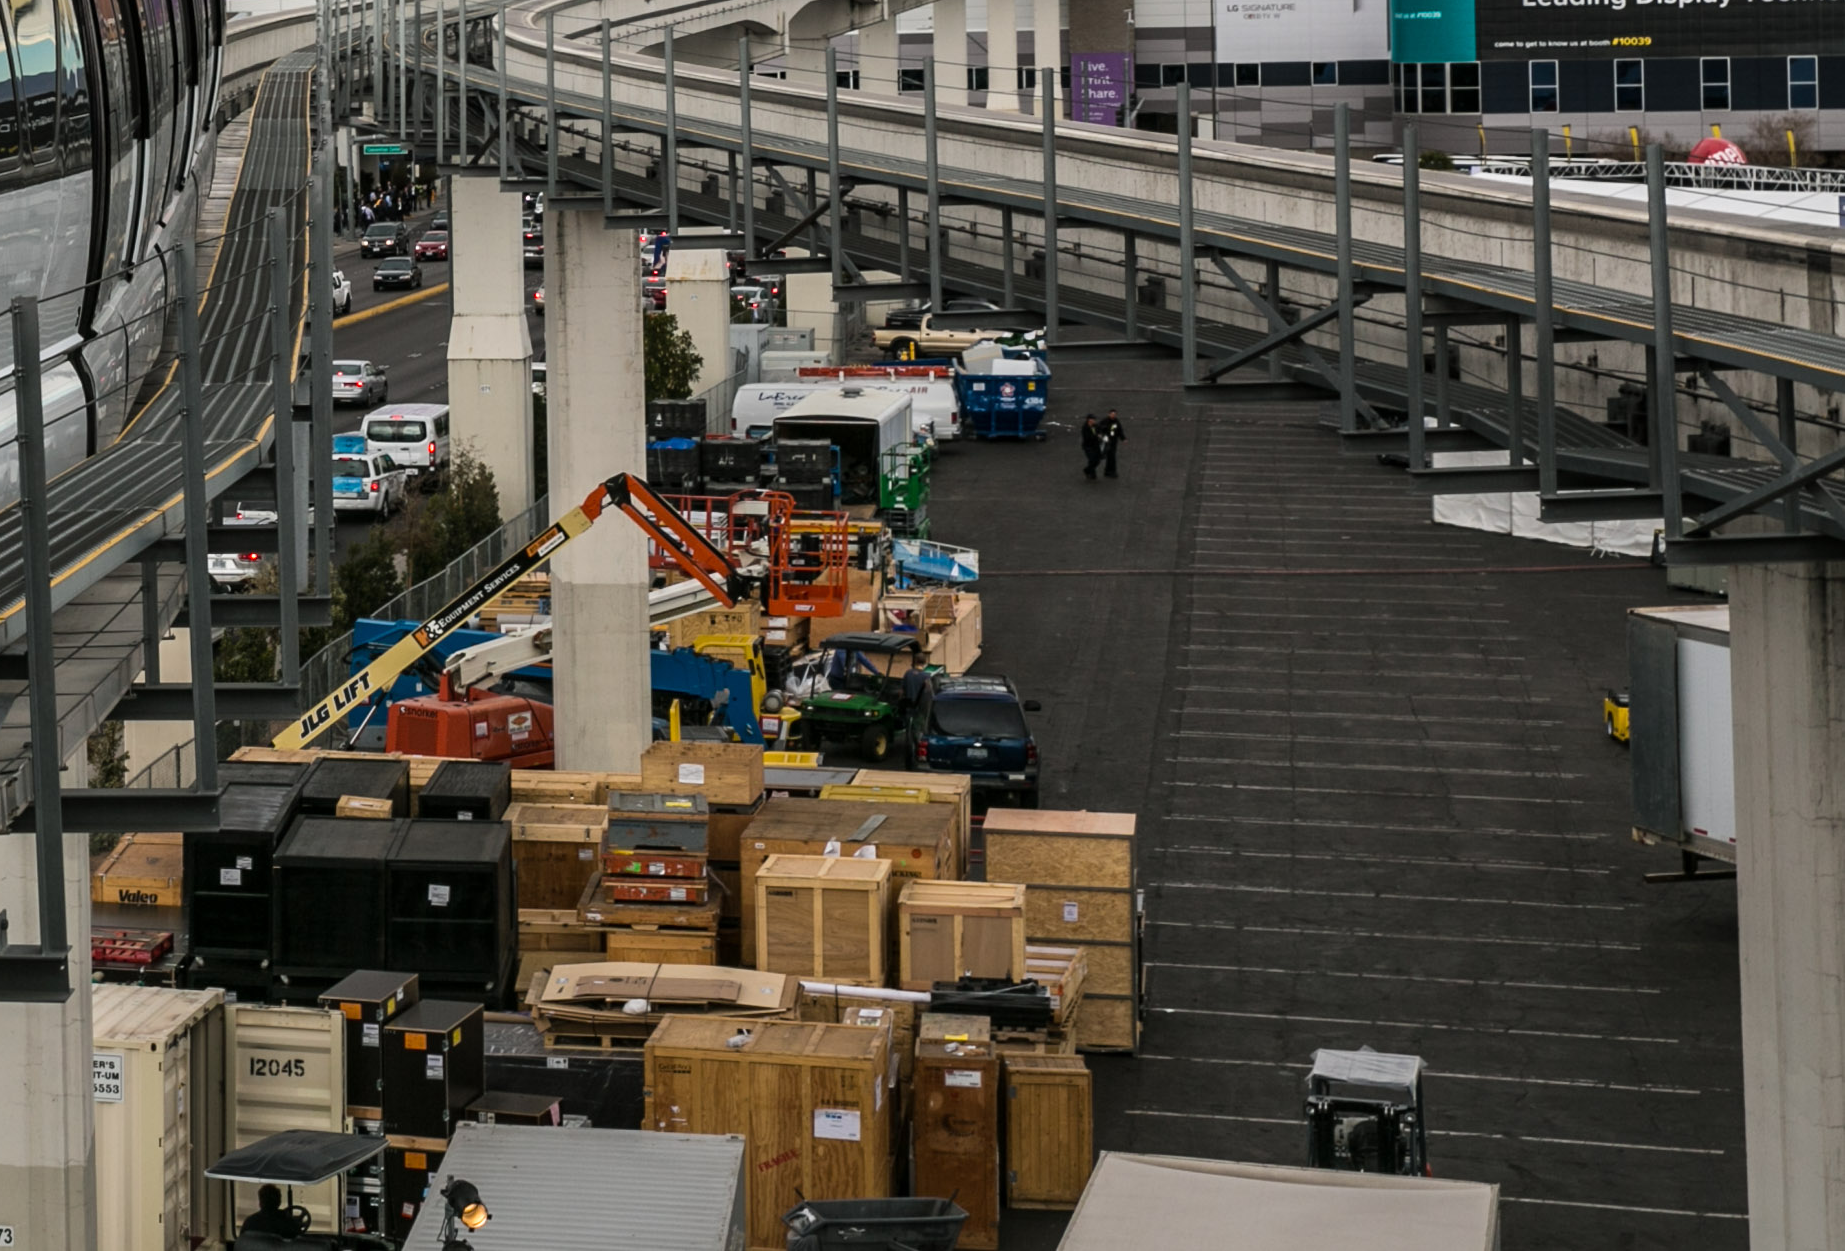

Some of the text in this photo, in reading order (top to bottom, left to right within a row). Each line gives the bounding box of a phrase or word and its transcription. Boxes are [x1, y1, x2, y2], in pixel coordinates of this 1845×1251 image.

[1241, 3, 1296, 12] SIGNATURE
[1525, 40, 1538, 48] get
[1612, 37, 1652, 46] #10039
[910, 386, 928, 394] AIR
[438, 592, 485, 628] EQUIPMENT
[483, 563, 521, 593] SERVICES
[299, 671, 370, 739] JLG LIFT
[119, 889, 158, 903] Valeo
[250, 1057, 305, 1077] 12045
[758, 1148, 800, 1172] FRAGILE
